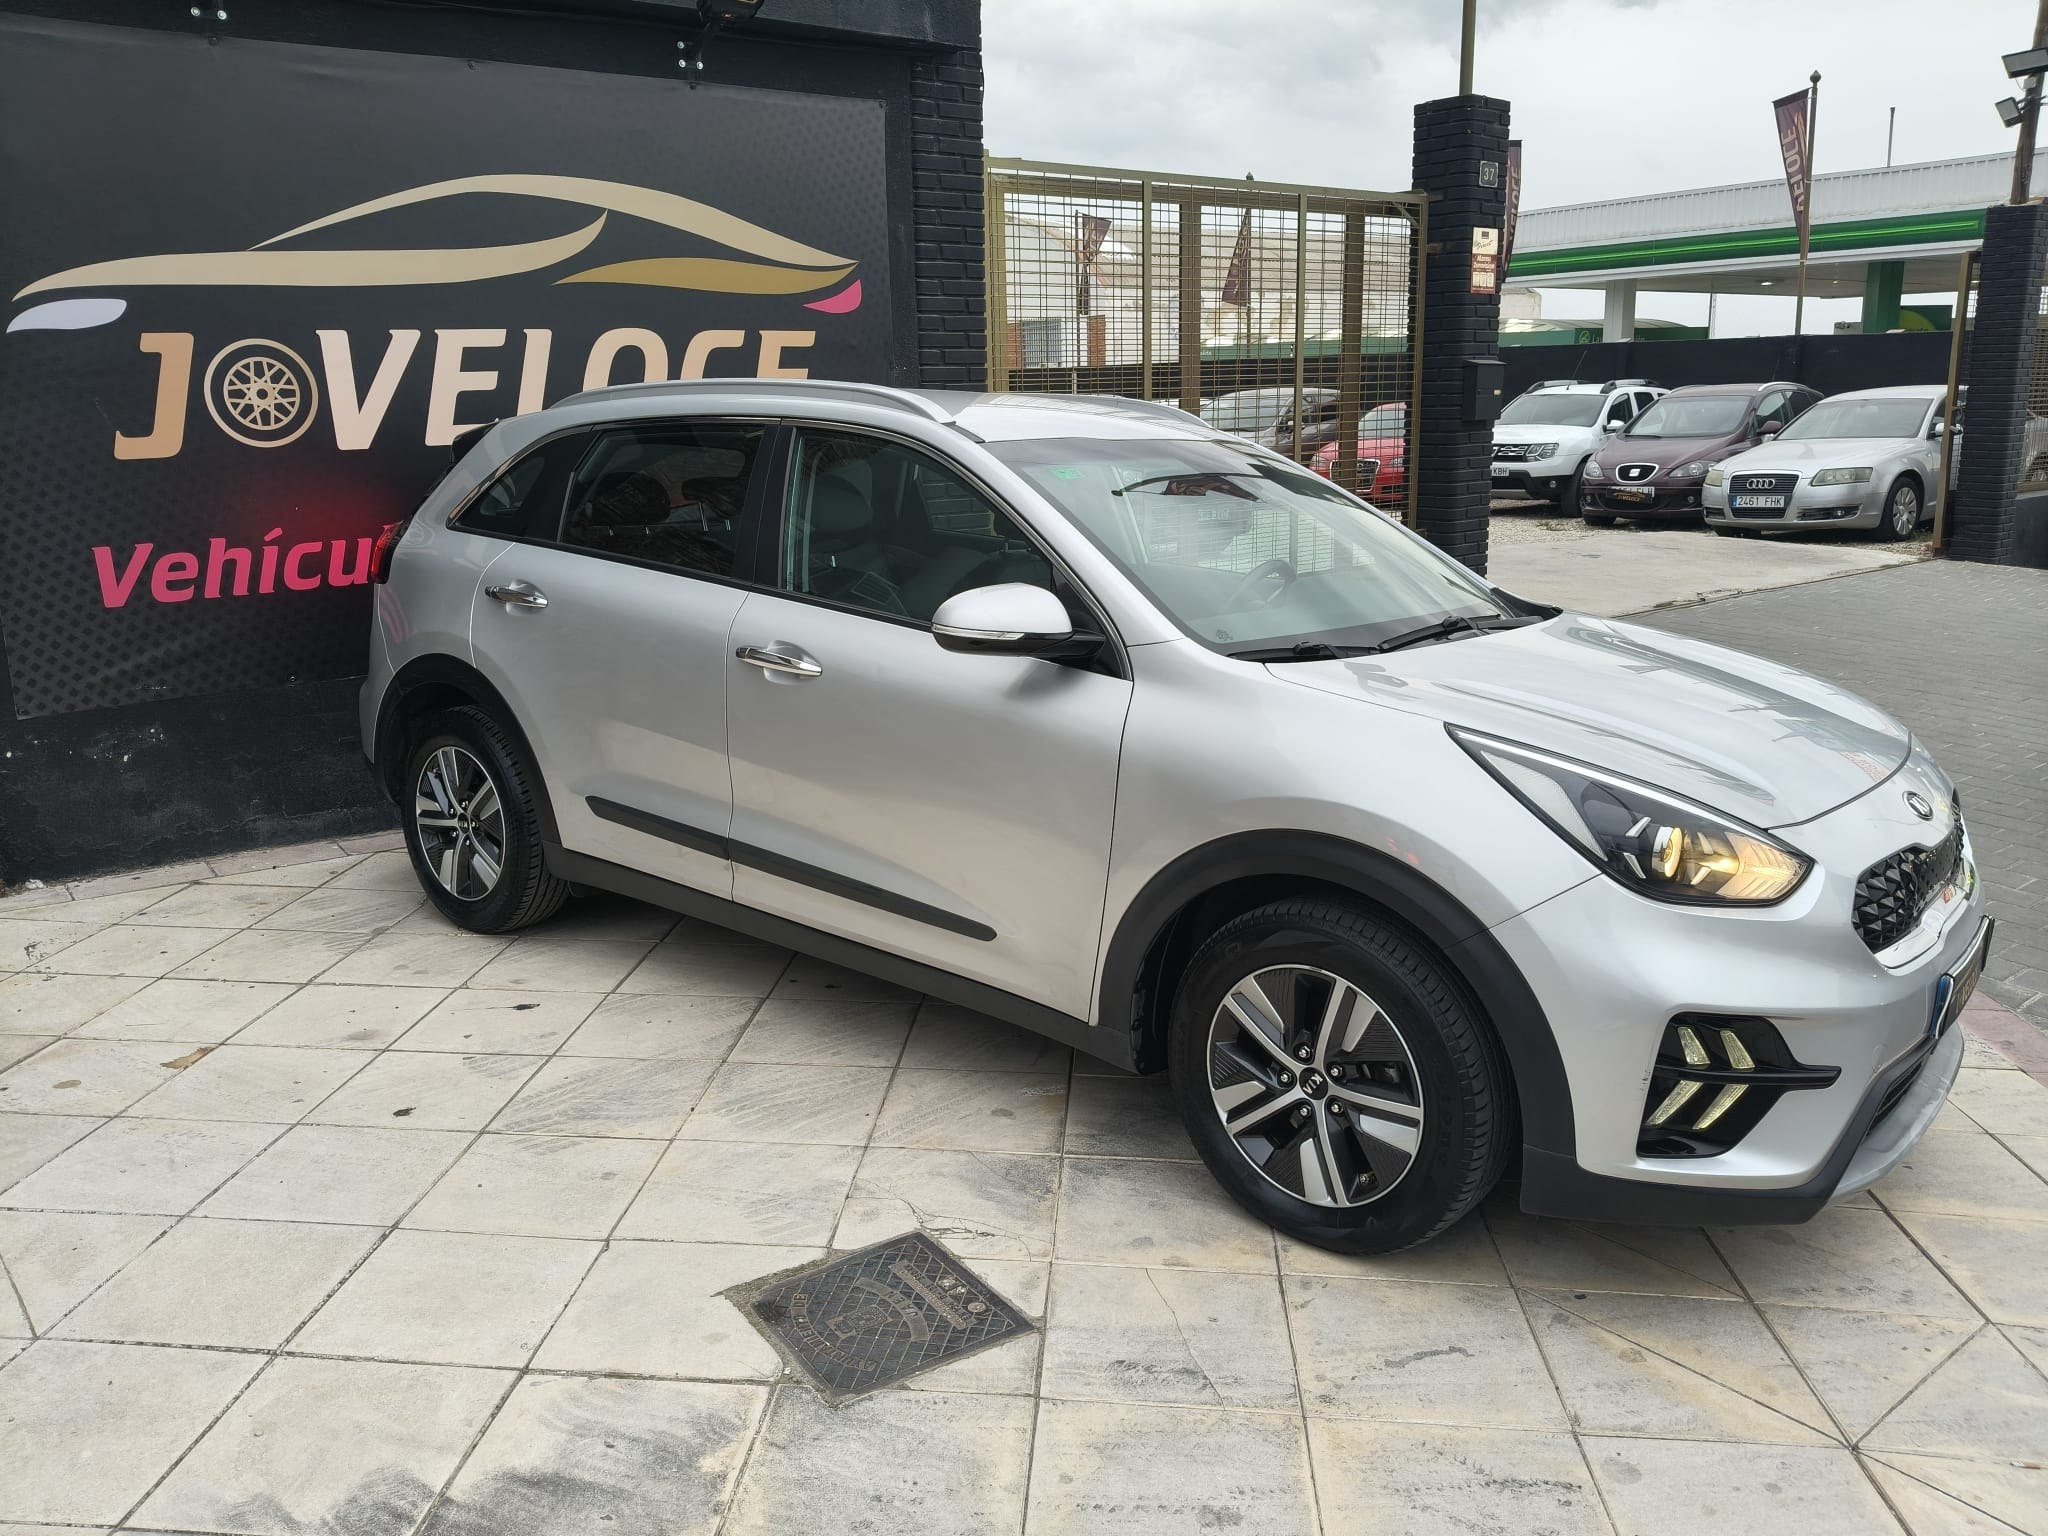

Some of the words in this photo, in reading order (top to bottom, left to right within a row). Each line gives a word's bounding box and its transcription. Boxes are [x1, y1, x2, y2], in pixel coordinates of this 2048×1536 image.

[1484, 168, 1495, 180] 37
[1738, 497, 1759, 506] 2461
[1764, 497, 1782, 506] FHK
[92, 524, 386, 609] Vehícu
[1302, 1072, 1324, 1095] KIA
